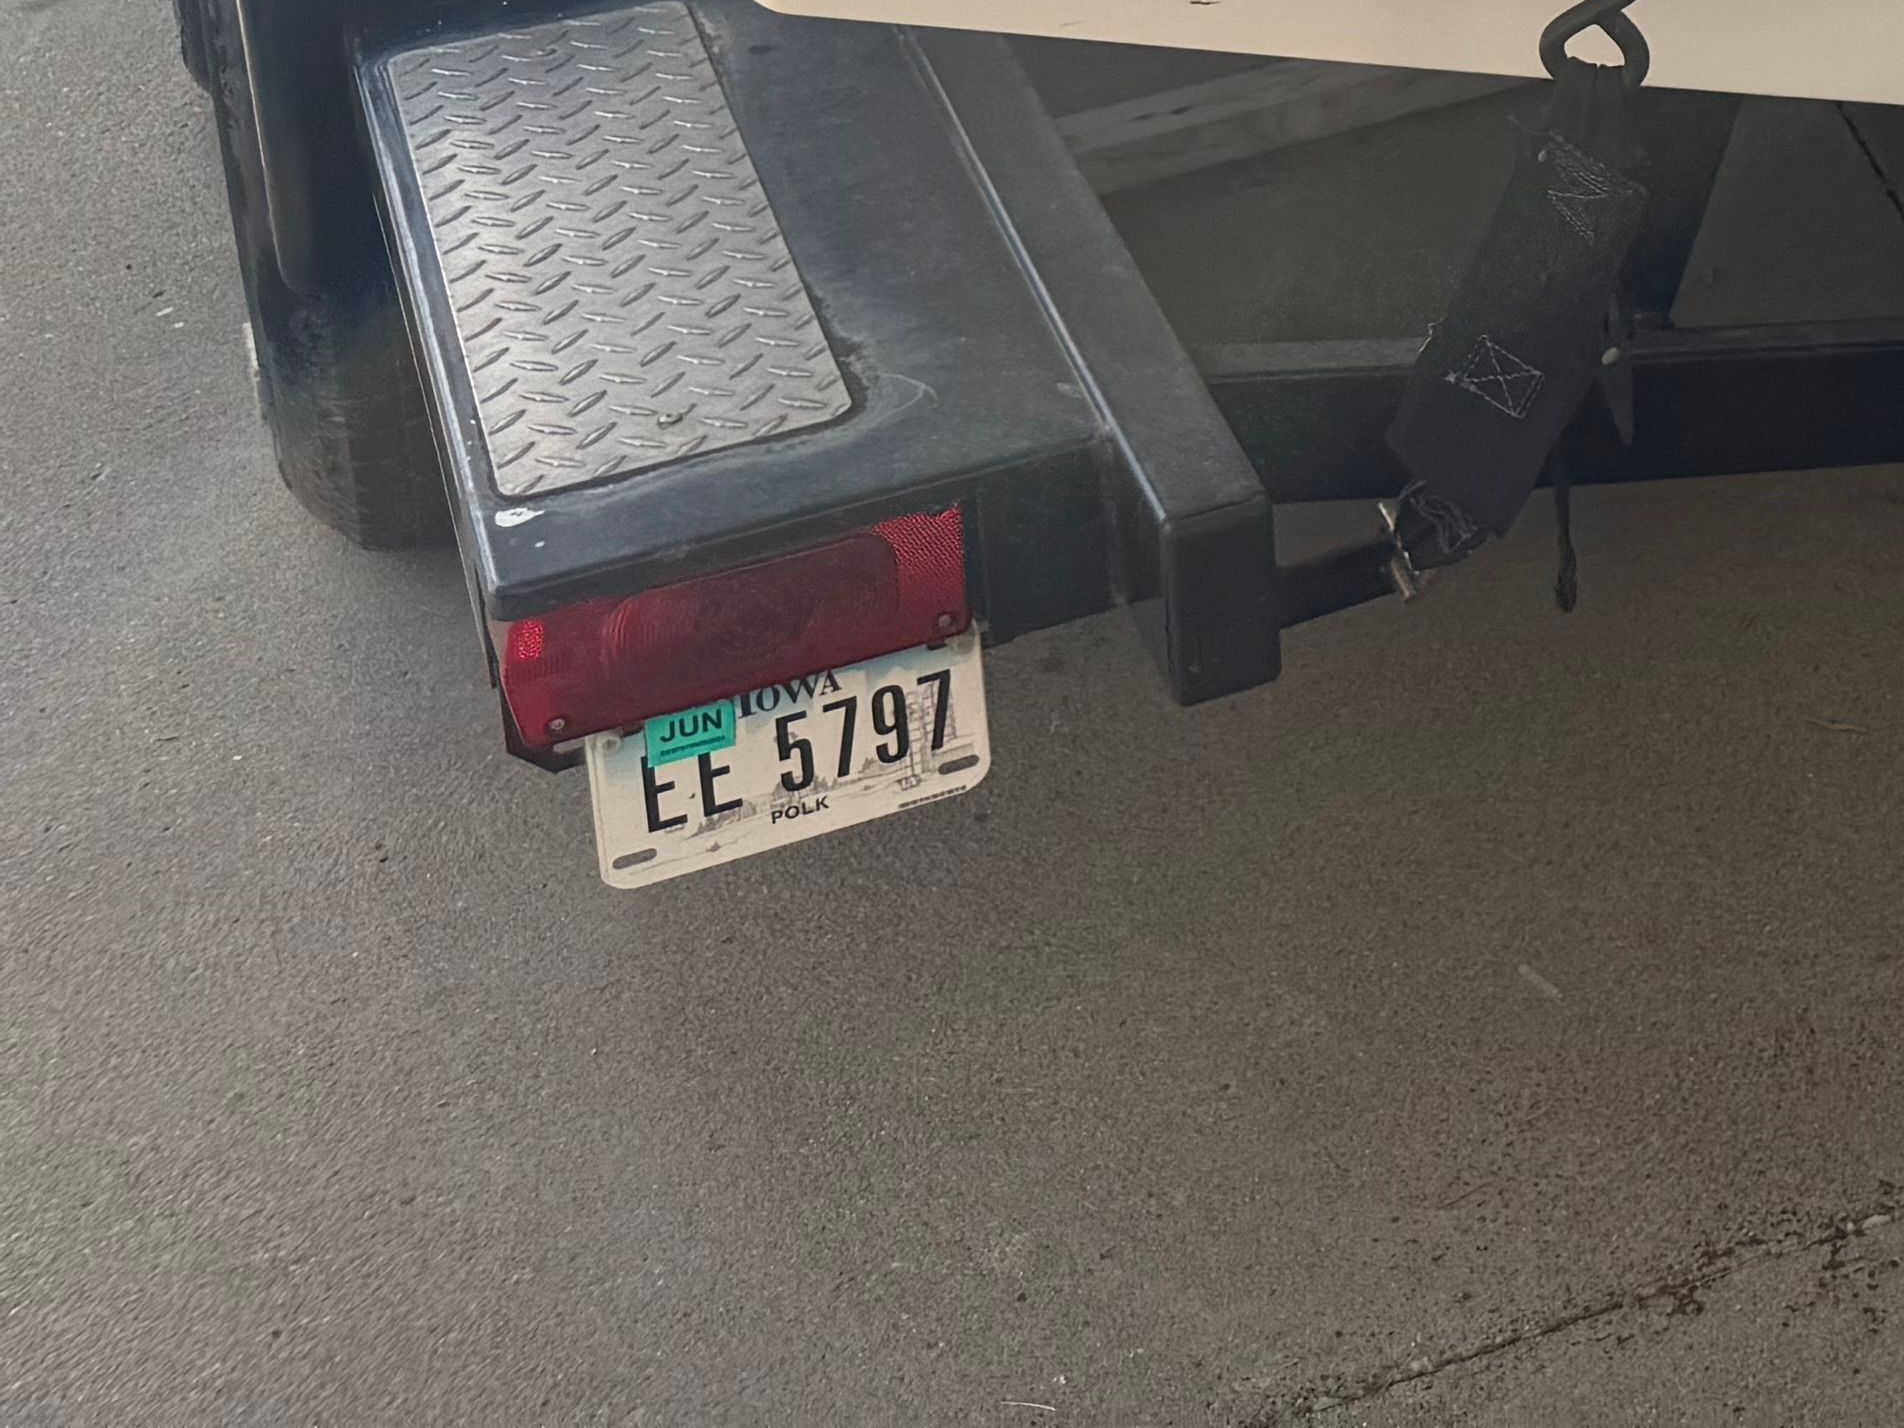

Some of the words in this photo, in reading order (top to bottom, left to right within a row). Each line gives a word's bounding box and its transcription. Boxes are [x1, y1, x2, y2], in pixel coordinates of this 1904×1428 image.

[738, 670, 842, 719] IOWA
[660, 708, 723, 743] JUN
[775, 669, 951, 793] 5797
[771, 795, 829, 825] POLK
